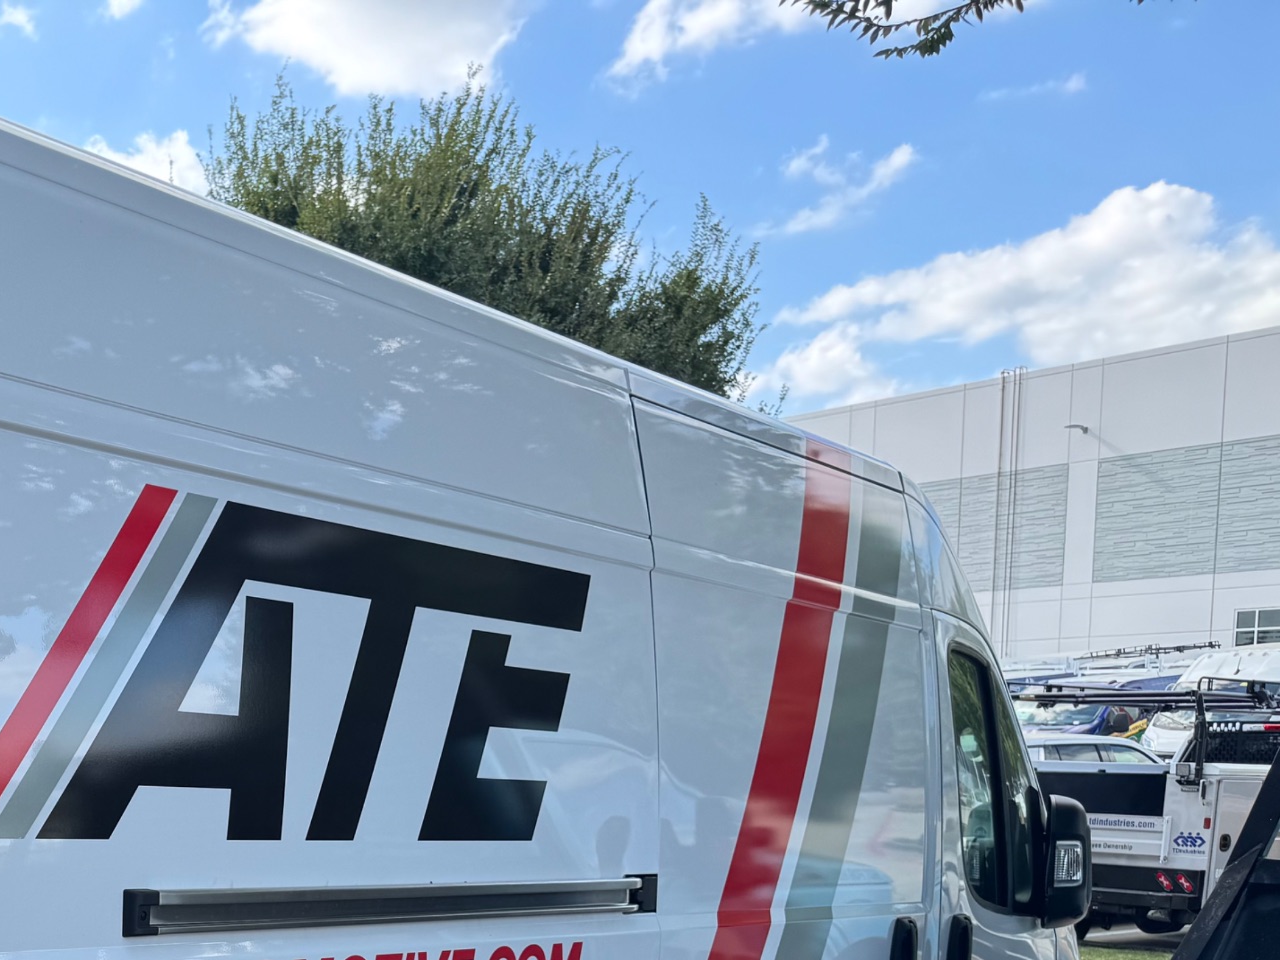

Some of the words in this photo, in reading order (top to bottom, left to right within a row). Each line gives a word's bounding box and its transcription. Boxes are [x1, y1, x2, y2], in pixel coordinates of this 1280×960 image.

[35, 500, 592, 841] ATE
[1088, 817, 1155, 829] tdindustries.com
[1103, 842, 1133, 852] Ownership
